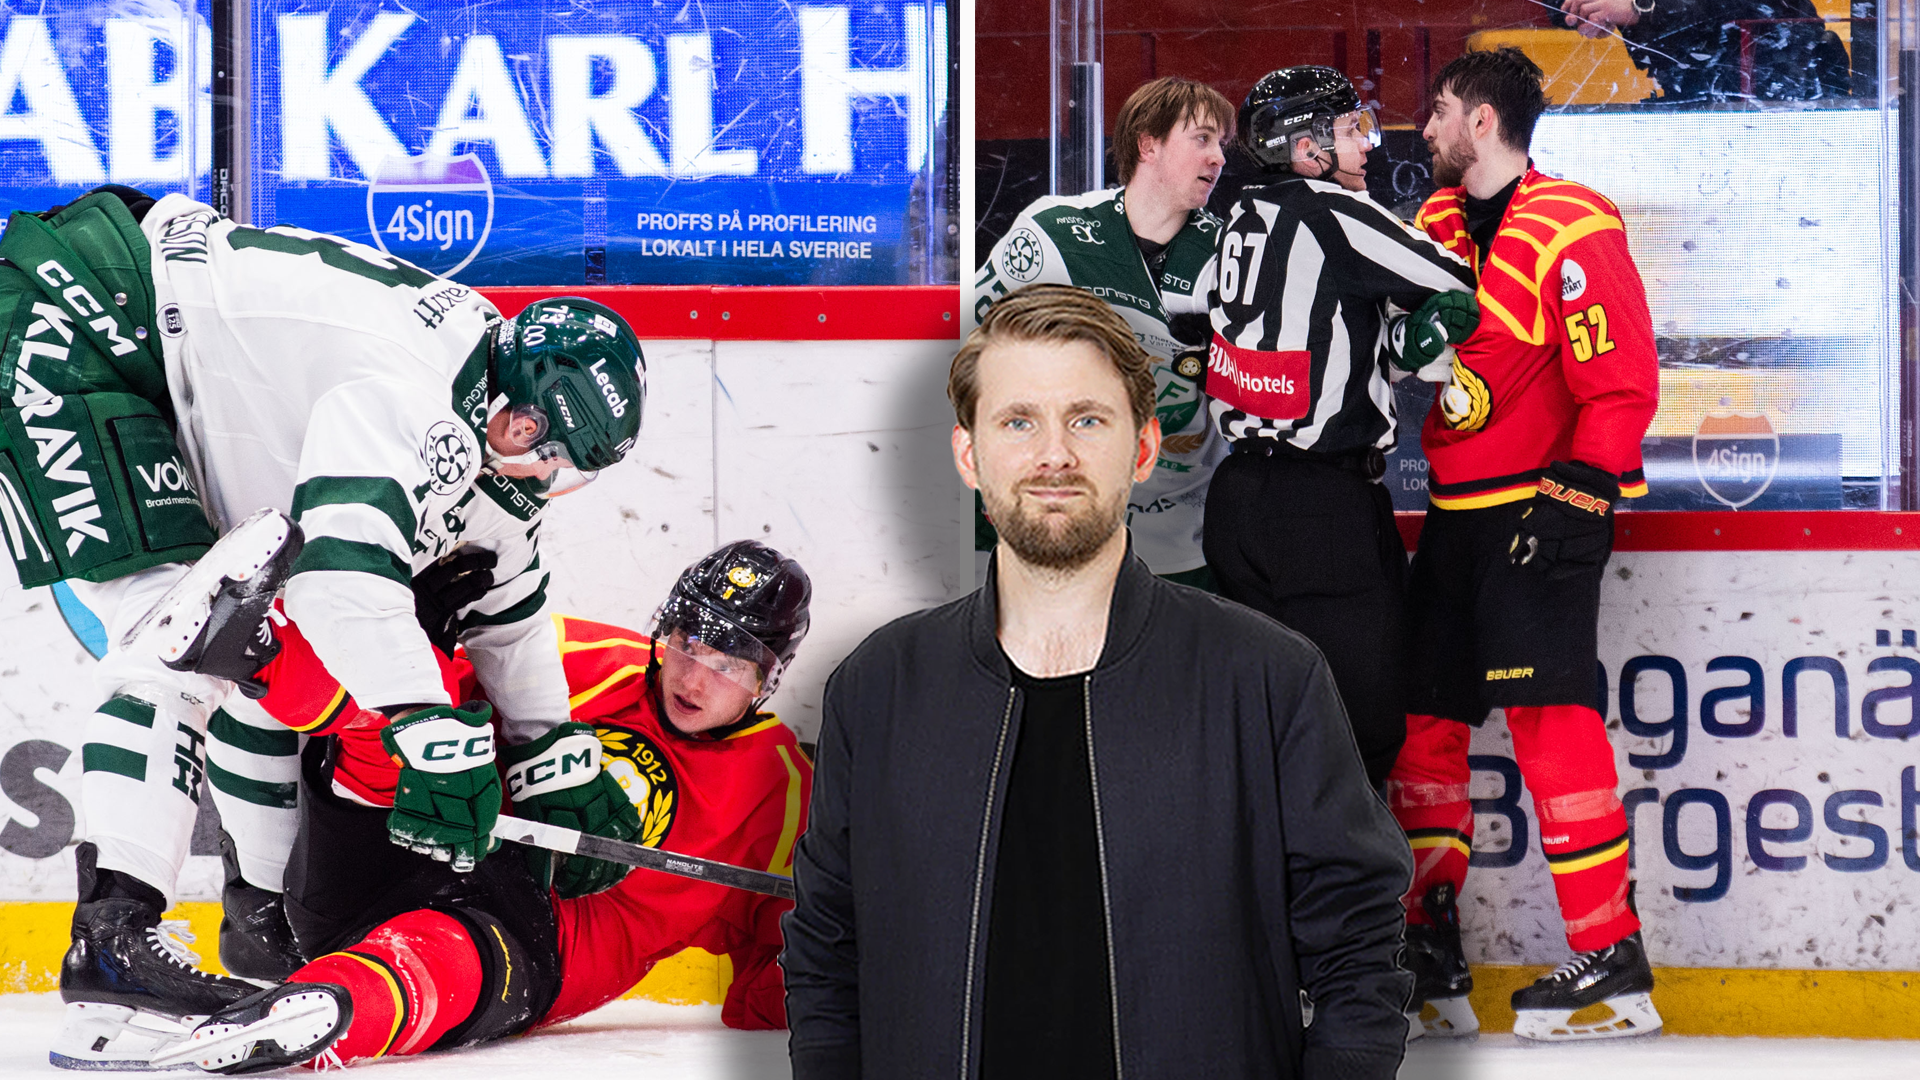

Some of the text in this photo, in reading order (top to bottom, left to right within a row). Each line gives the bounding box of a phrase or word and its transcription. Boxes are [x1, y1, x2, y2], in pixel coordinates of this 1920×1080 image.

[277, 10, 758, 180] KARL
[1284, 112, 1314, 126] CCM
[387, 199, 474, 251] 4Sign
[637, 209, 877, 233] PROFFS PÅ PROFILERING
[641, 239, 872, 259] LOKALT I HELA SVERIGE
[1219, 231, 1268, 306] 67
[36, 260, 138, 357] CCM
[1420, 336, 1433, 349] CCM
[1564, 303, 1617, 364] 52
[589, 357, 630, 418] Lecab
[1239, 370, 1295, 395] Hotels
[12, 302, 110, 558] KLARAVIK
[555, 394, 576, 428] CCM
[1400, 459, 1430, 472] PRO
[1706, 444, 1766, 484] 4Sign
[145, 496, 172, 509] Brand
[1486, 667, 1535, 681] BAUER
[1598, 628, 1920, 770] ganä
[421, 735, 495, 762] CC
[631, 742, 668, 785] 1912
[507, 747, 592, 797] CCM
[1468, 754, 1920, 904] Brgest
